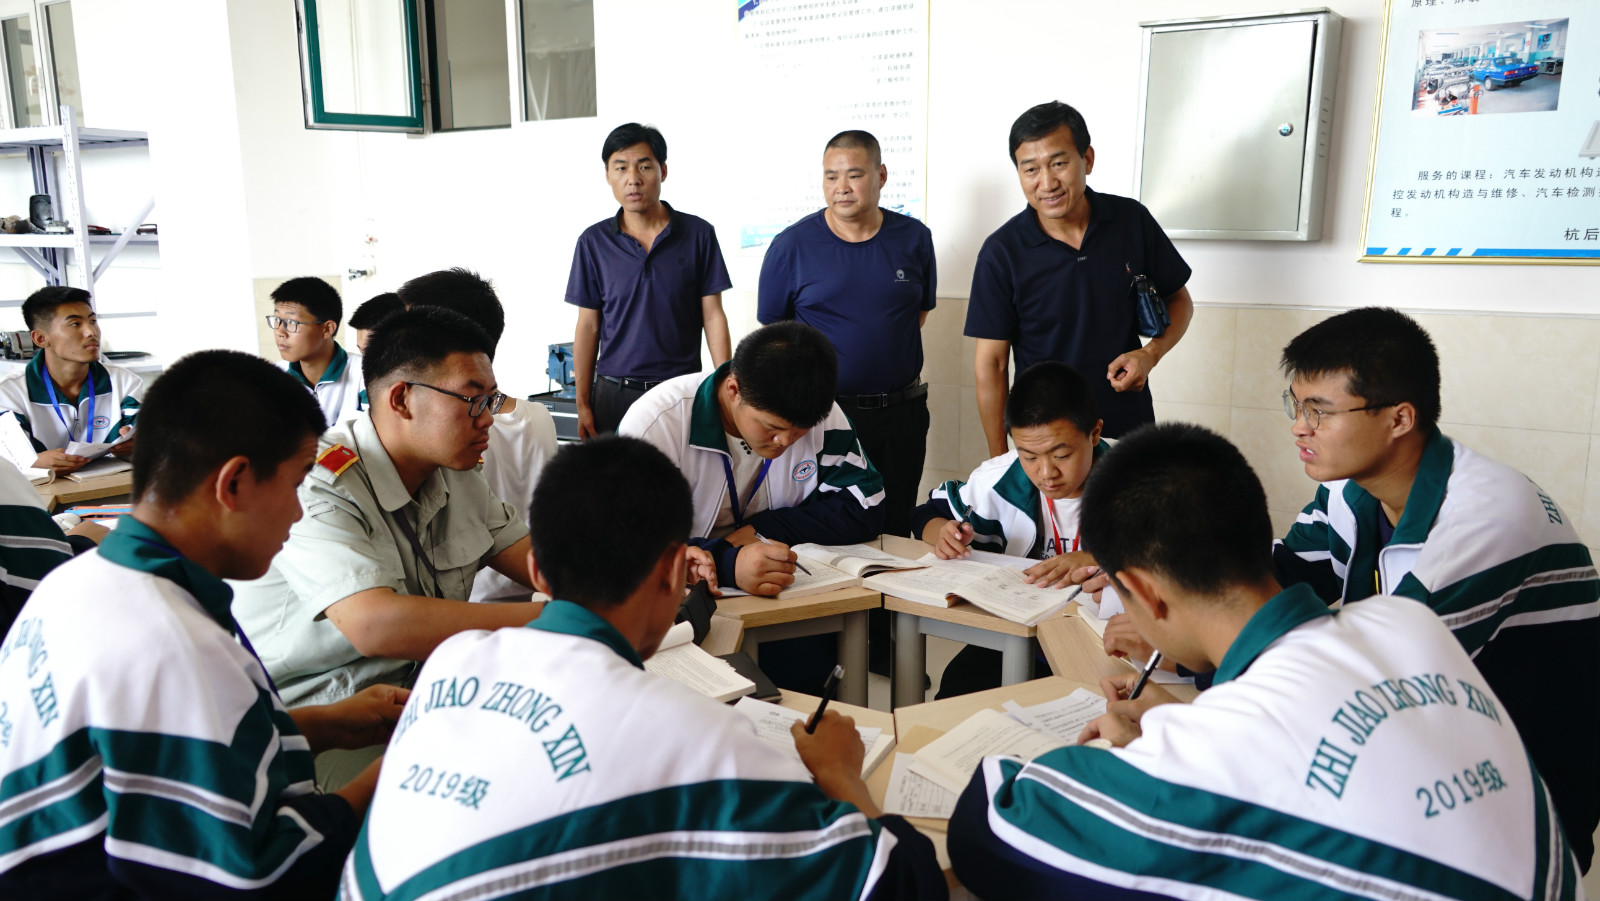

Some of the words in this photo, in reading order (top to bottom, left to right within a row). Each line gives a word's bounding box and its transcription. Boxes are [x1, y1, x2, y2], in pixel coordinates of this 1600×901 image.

[1392, 186, 1600, 200] 控发动机构造与维修、汽车检测
[1563, 227, 1600, 241] 杭后
[1536, 491, 1563, 525] ZHI
[31, 672, 59, 728] XIN
[1372, 673, 1458, 711] ZHONG
[1456, 678, 1503, 727] XIN
[424, 676, 480, 714] JIAO
[480, 681, 563, 733] ZHONG
[542, 723, 591, 783] XIN
[1331, 689, 1389, 746] JIAO
[399, 764, 491, 810] 2019级
[1305, 737, 1358, 800] ZHI
[1416, 758, 1508, 819] 2019级
